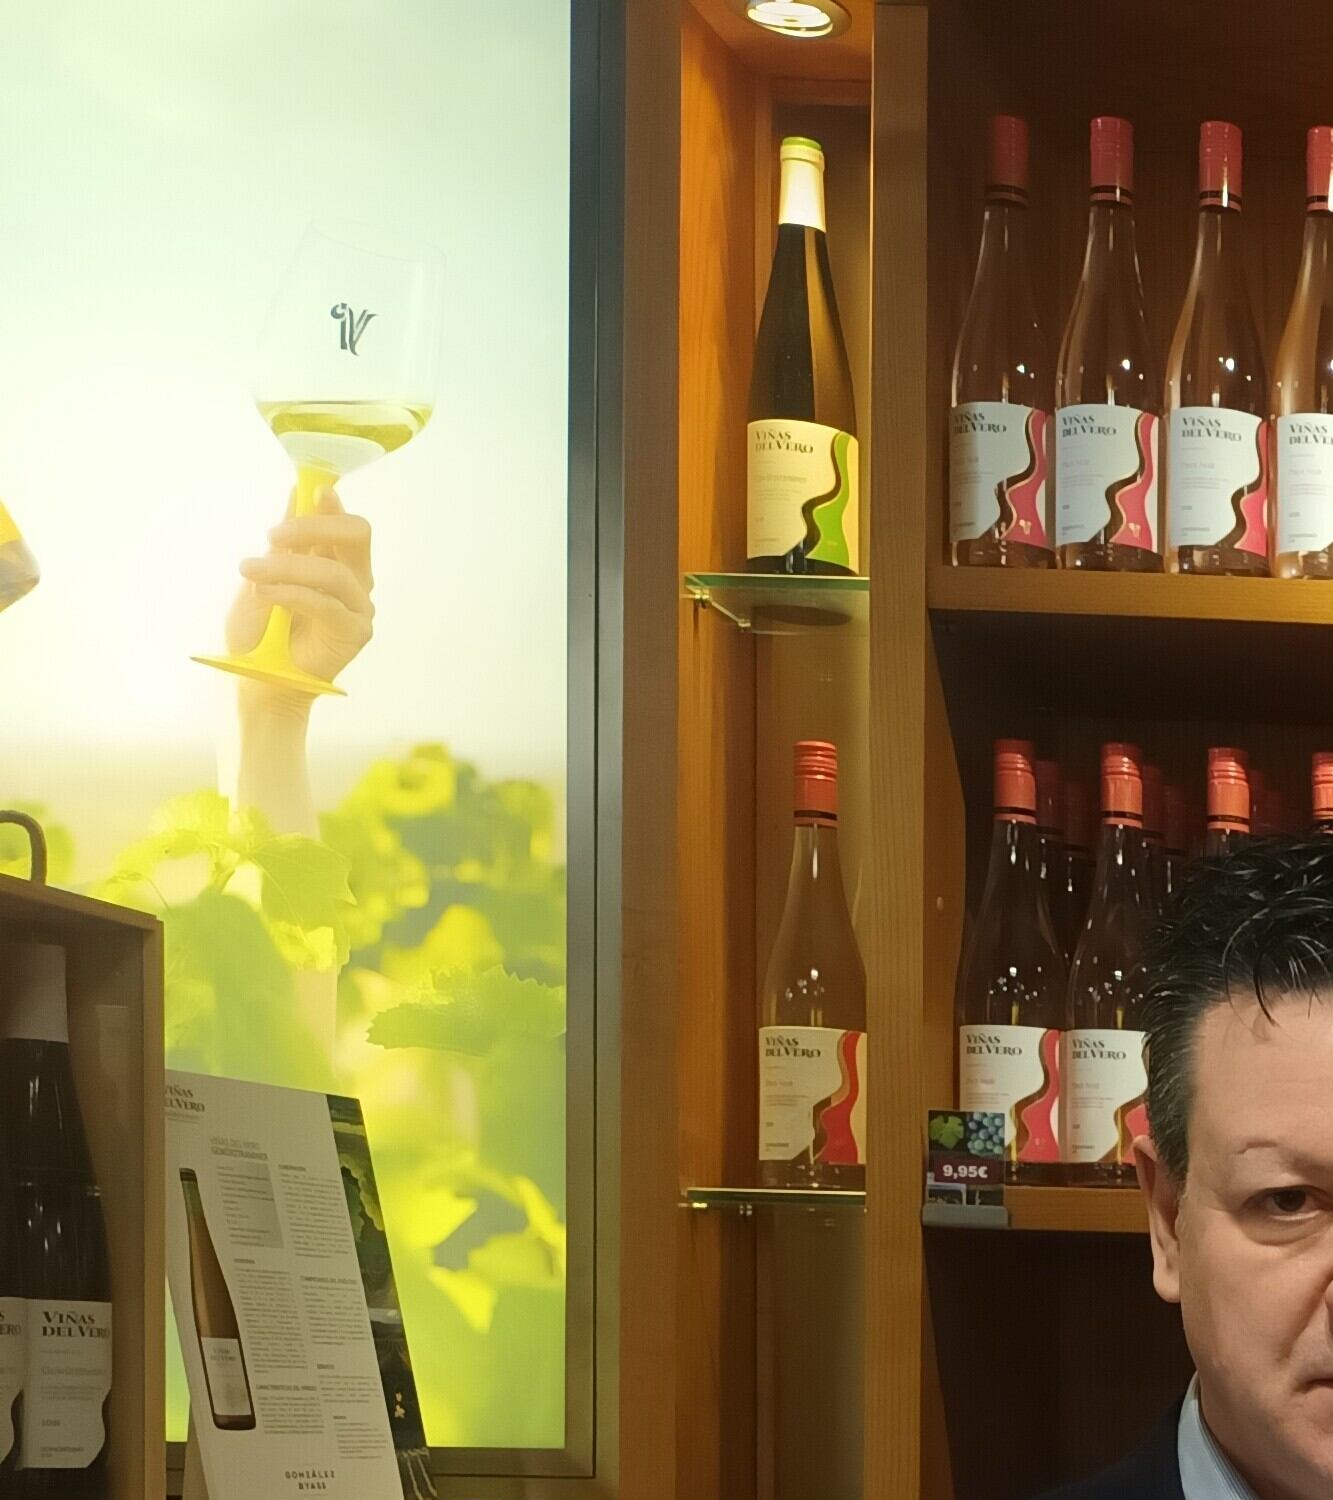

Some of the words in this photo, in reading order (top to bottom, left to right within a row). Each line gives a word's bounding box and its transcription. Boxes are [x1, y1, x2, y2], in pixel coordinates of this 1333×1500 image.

[765, 1034, 800, 1047] VIÑAS
[966, 1032, 1001, 1046] VIÑAS
[1072, 1036, 1105, 1050] VIÑAS
[942, 1164, 989, 1180] 9,95€
[43, 1310, 96, 1325] VIÑAS
